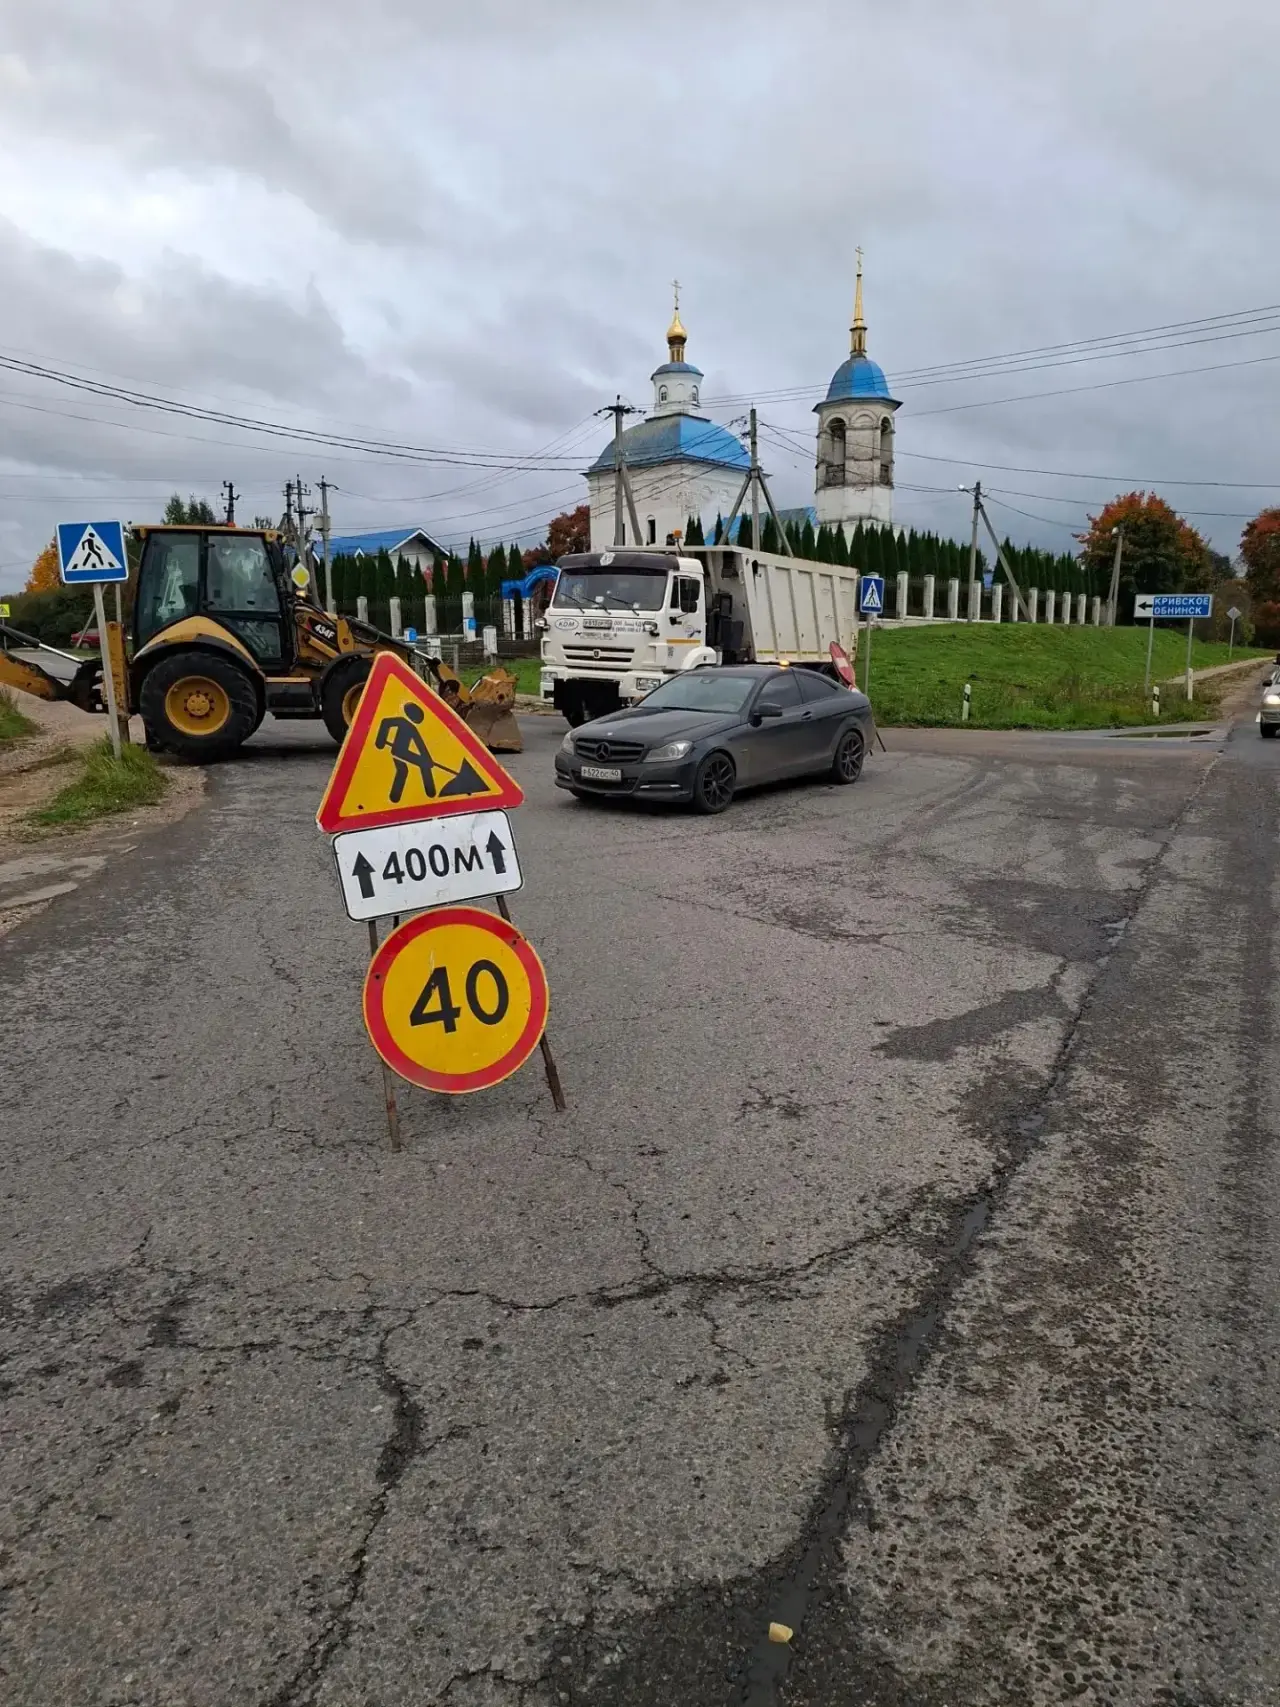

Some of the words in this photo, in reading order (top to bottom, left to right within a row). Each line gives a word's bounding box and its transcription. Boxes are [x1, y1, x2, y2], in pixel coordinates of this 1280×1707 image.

[1154, 597, 1209, 605] КРИВСКОЕ
[1154, 606, 1202, 614] ОБНИНСК
[314, 624, 335, 639] 434F
[409, 959, 509, 1033] 40
